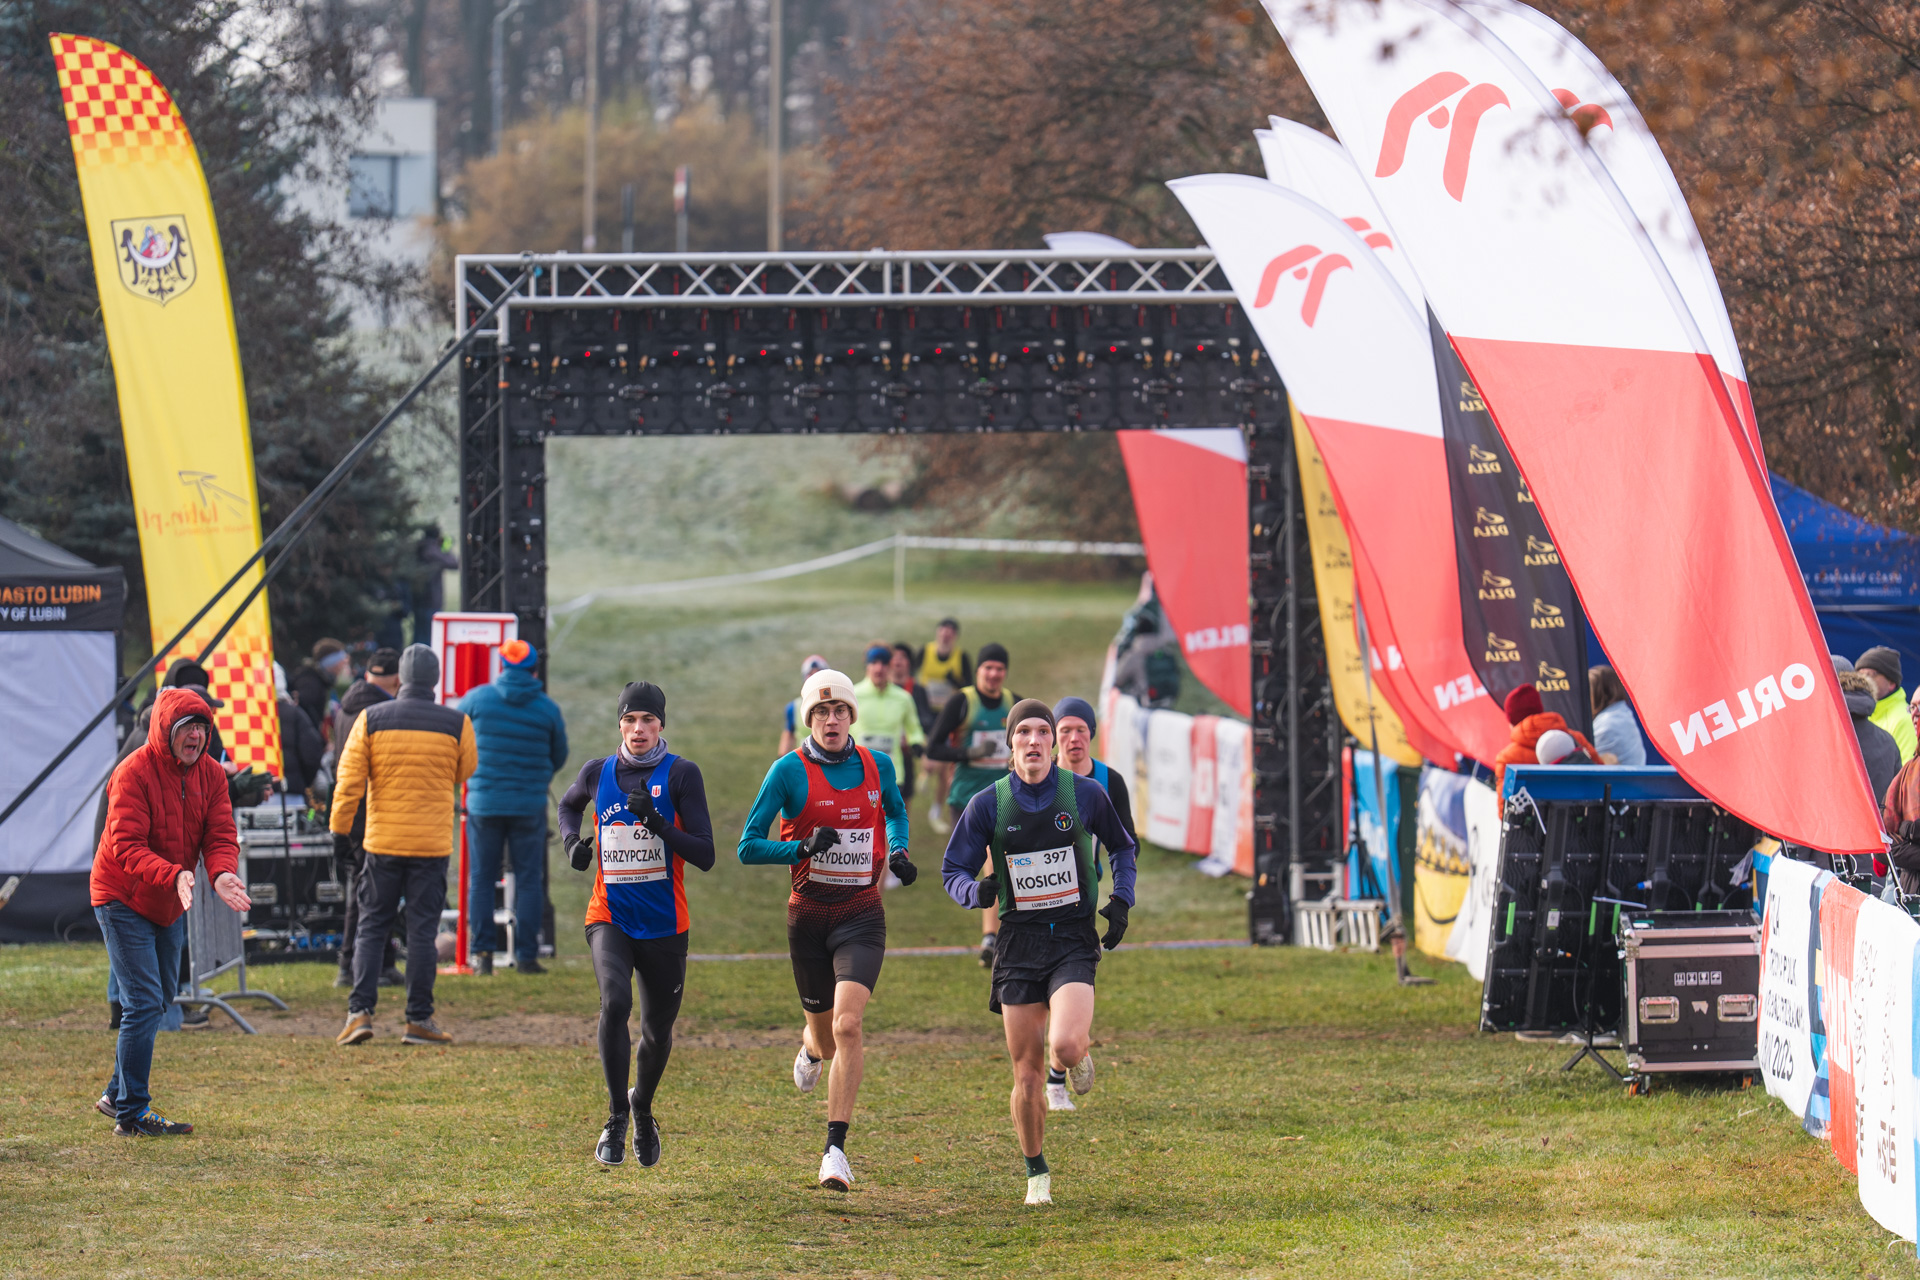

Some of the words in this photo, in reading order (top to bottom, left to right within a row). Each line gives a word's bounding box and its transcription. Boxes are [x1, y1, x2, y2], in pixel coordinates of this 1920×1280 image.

[51, 584, 102, 604] LUBIN
[11, 607, 28, 621] OF
[29, 606, 67, 621] LUBIN
[601, 803, 622, 823] UKS
[849, 832, 871, 843] 549
[604, 848, 662, 863] SKRZYPCZAK
[1043, 850, 1068, 865] 397
[1015, 870, 1072, 891] KOSICKI
